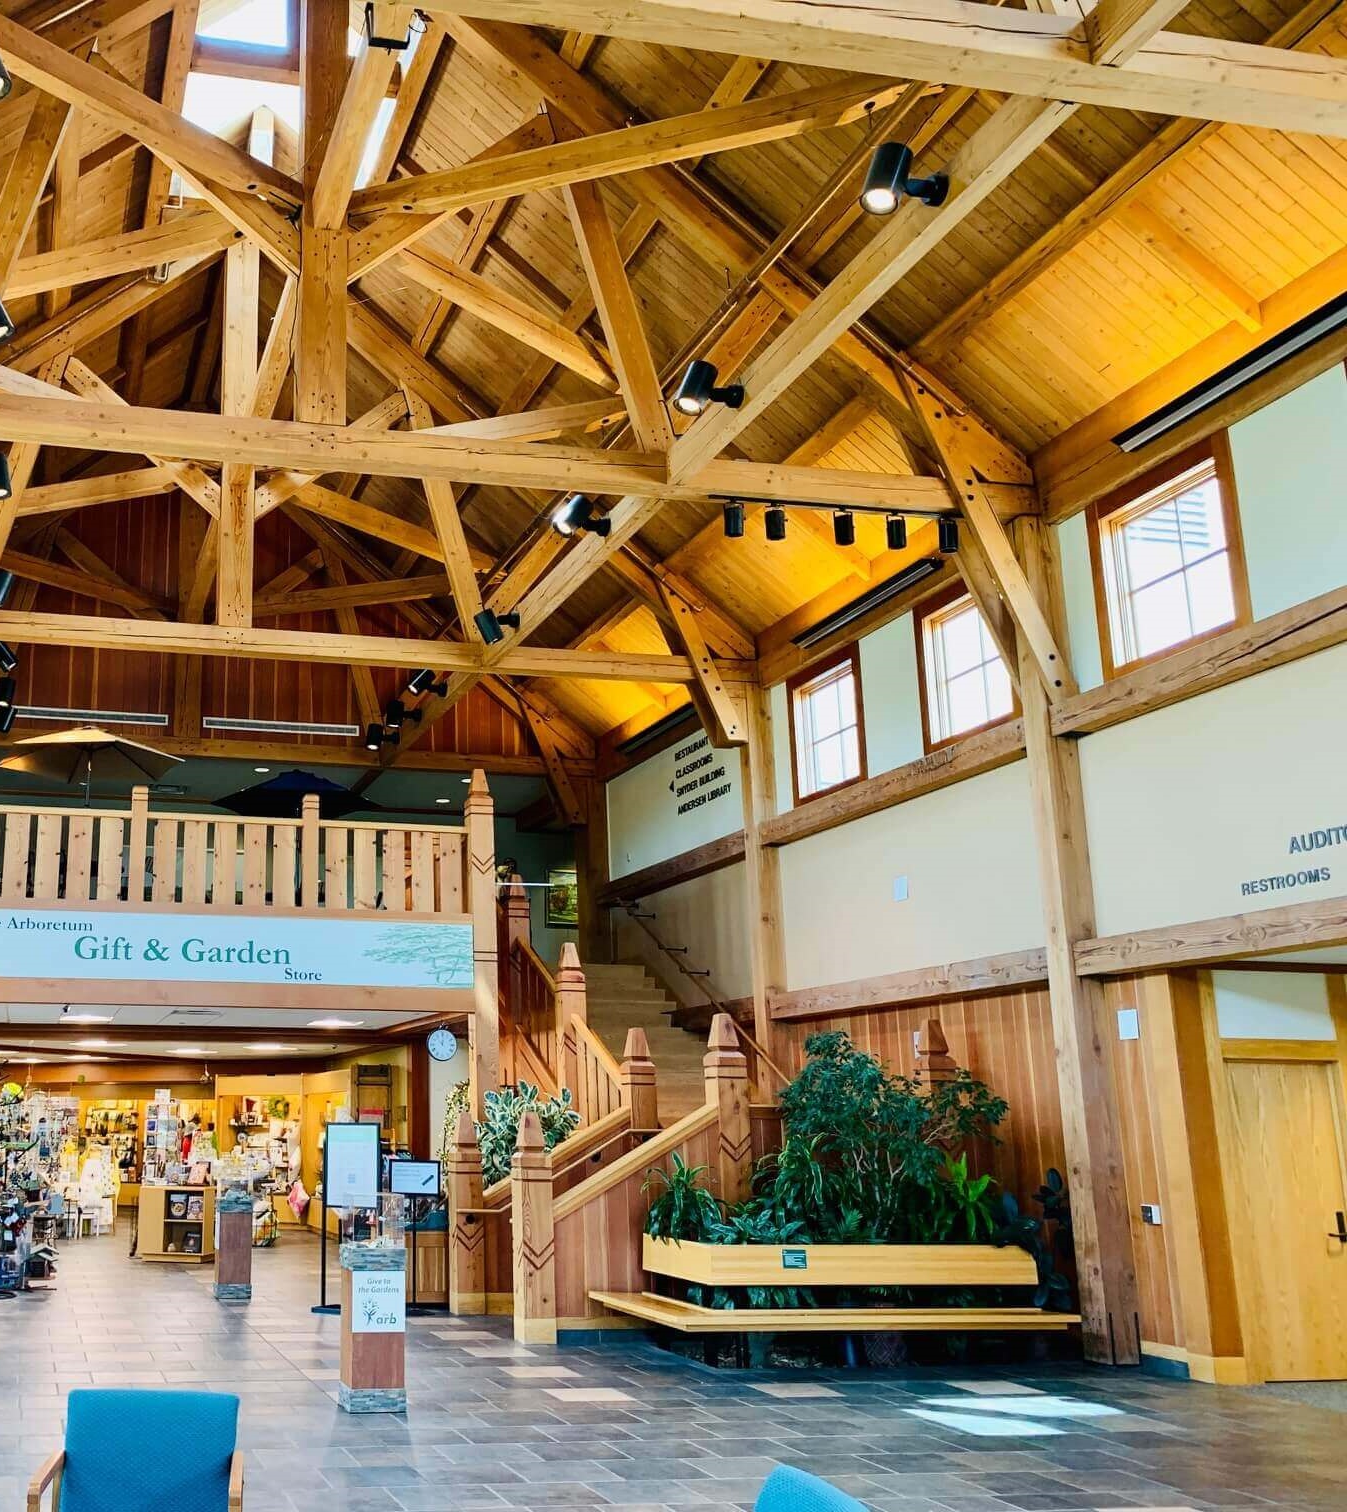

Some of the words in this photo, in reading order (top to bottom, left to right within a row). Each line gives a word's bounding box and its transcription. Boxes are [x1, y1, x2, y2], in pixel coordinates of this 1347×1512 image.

[674, 735, 708, 761] RESTAURANT
[675, 752, 713, 779] CLASSROOMS
[707, 782, 731, 801] LIBRARY
[1240, 866, 1332, 896] RESTROOMS
[7, 915, 94, 932] Arboretum
[74, 935, 134, 962] Gift
[142, 938, 171, 962] &
[181, 938, 292, 966] Garden
[283, 968, 323, 982] Store
[376, 1312, 397, 1324] arb
